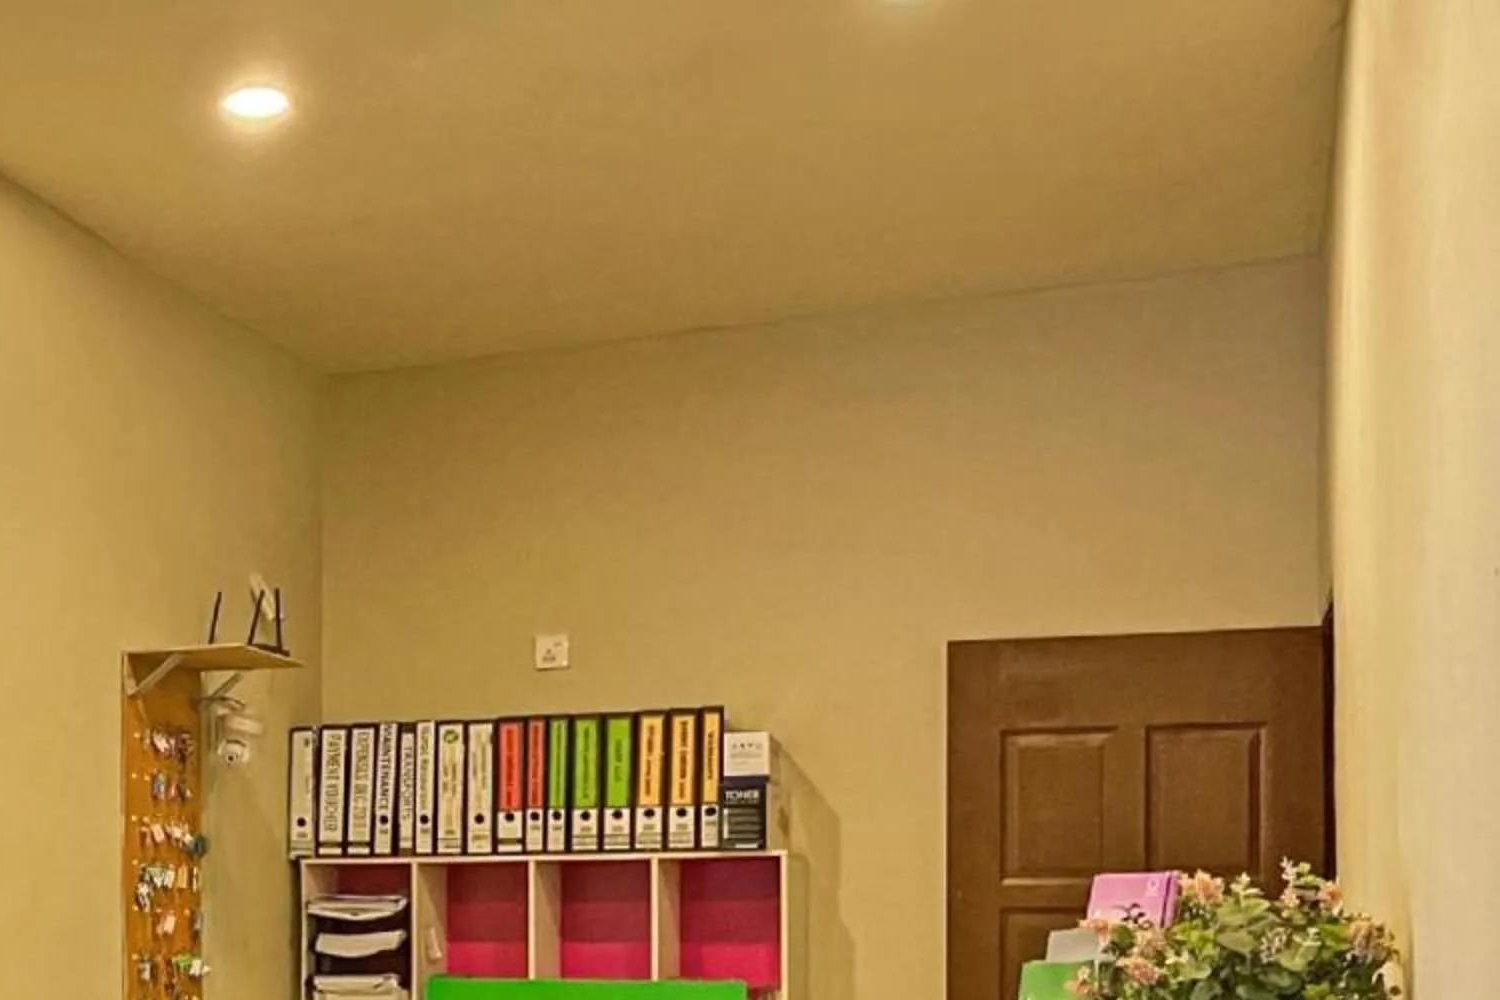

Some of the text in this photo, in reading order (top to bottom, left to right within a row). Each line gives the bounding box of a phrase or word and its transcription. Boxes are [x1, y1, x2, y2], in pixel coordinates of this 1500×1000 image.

[323, 734, 342, 832] PAYMENT VOUCHER
[378, 724, 394, 811] MAINTENANCE
[725, 789, 759, 799] TONER
